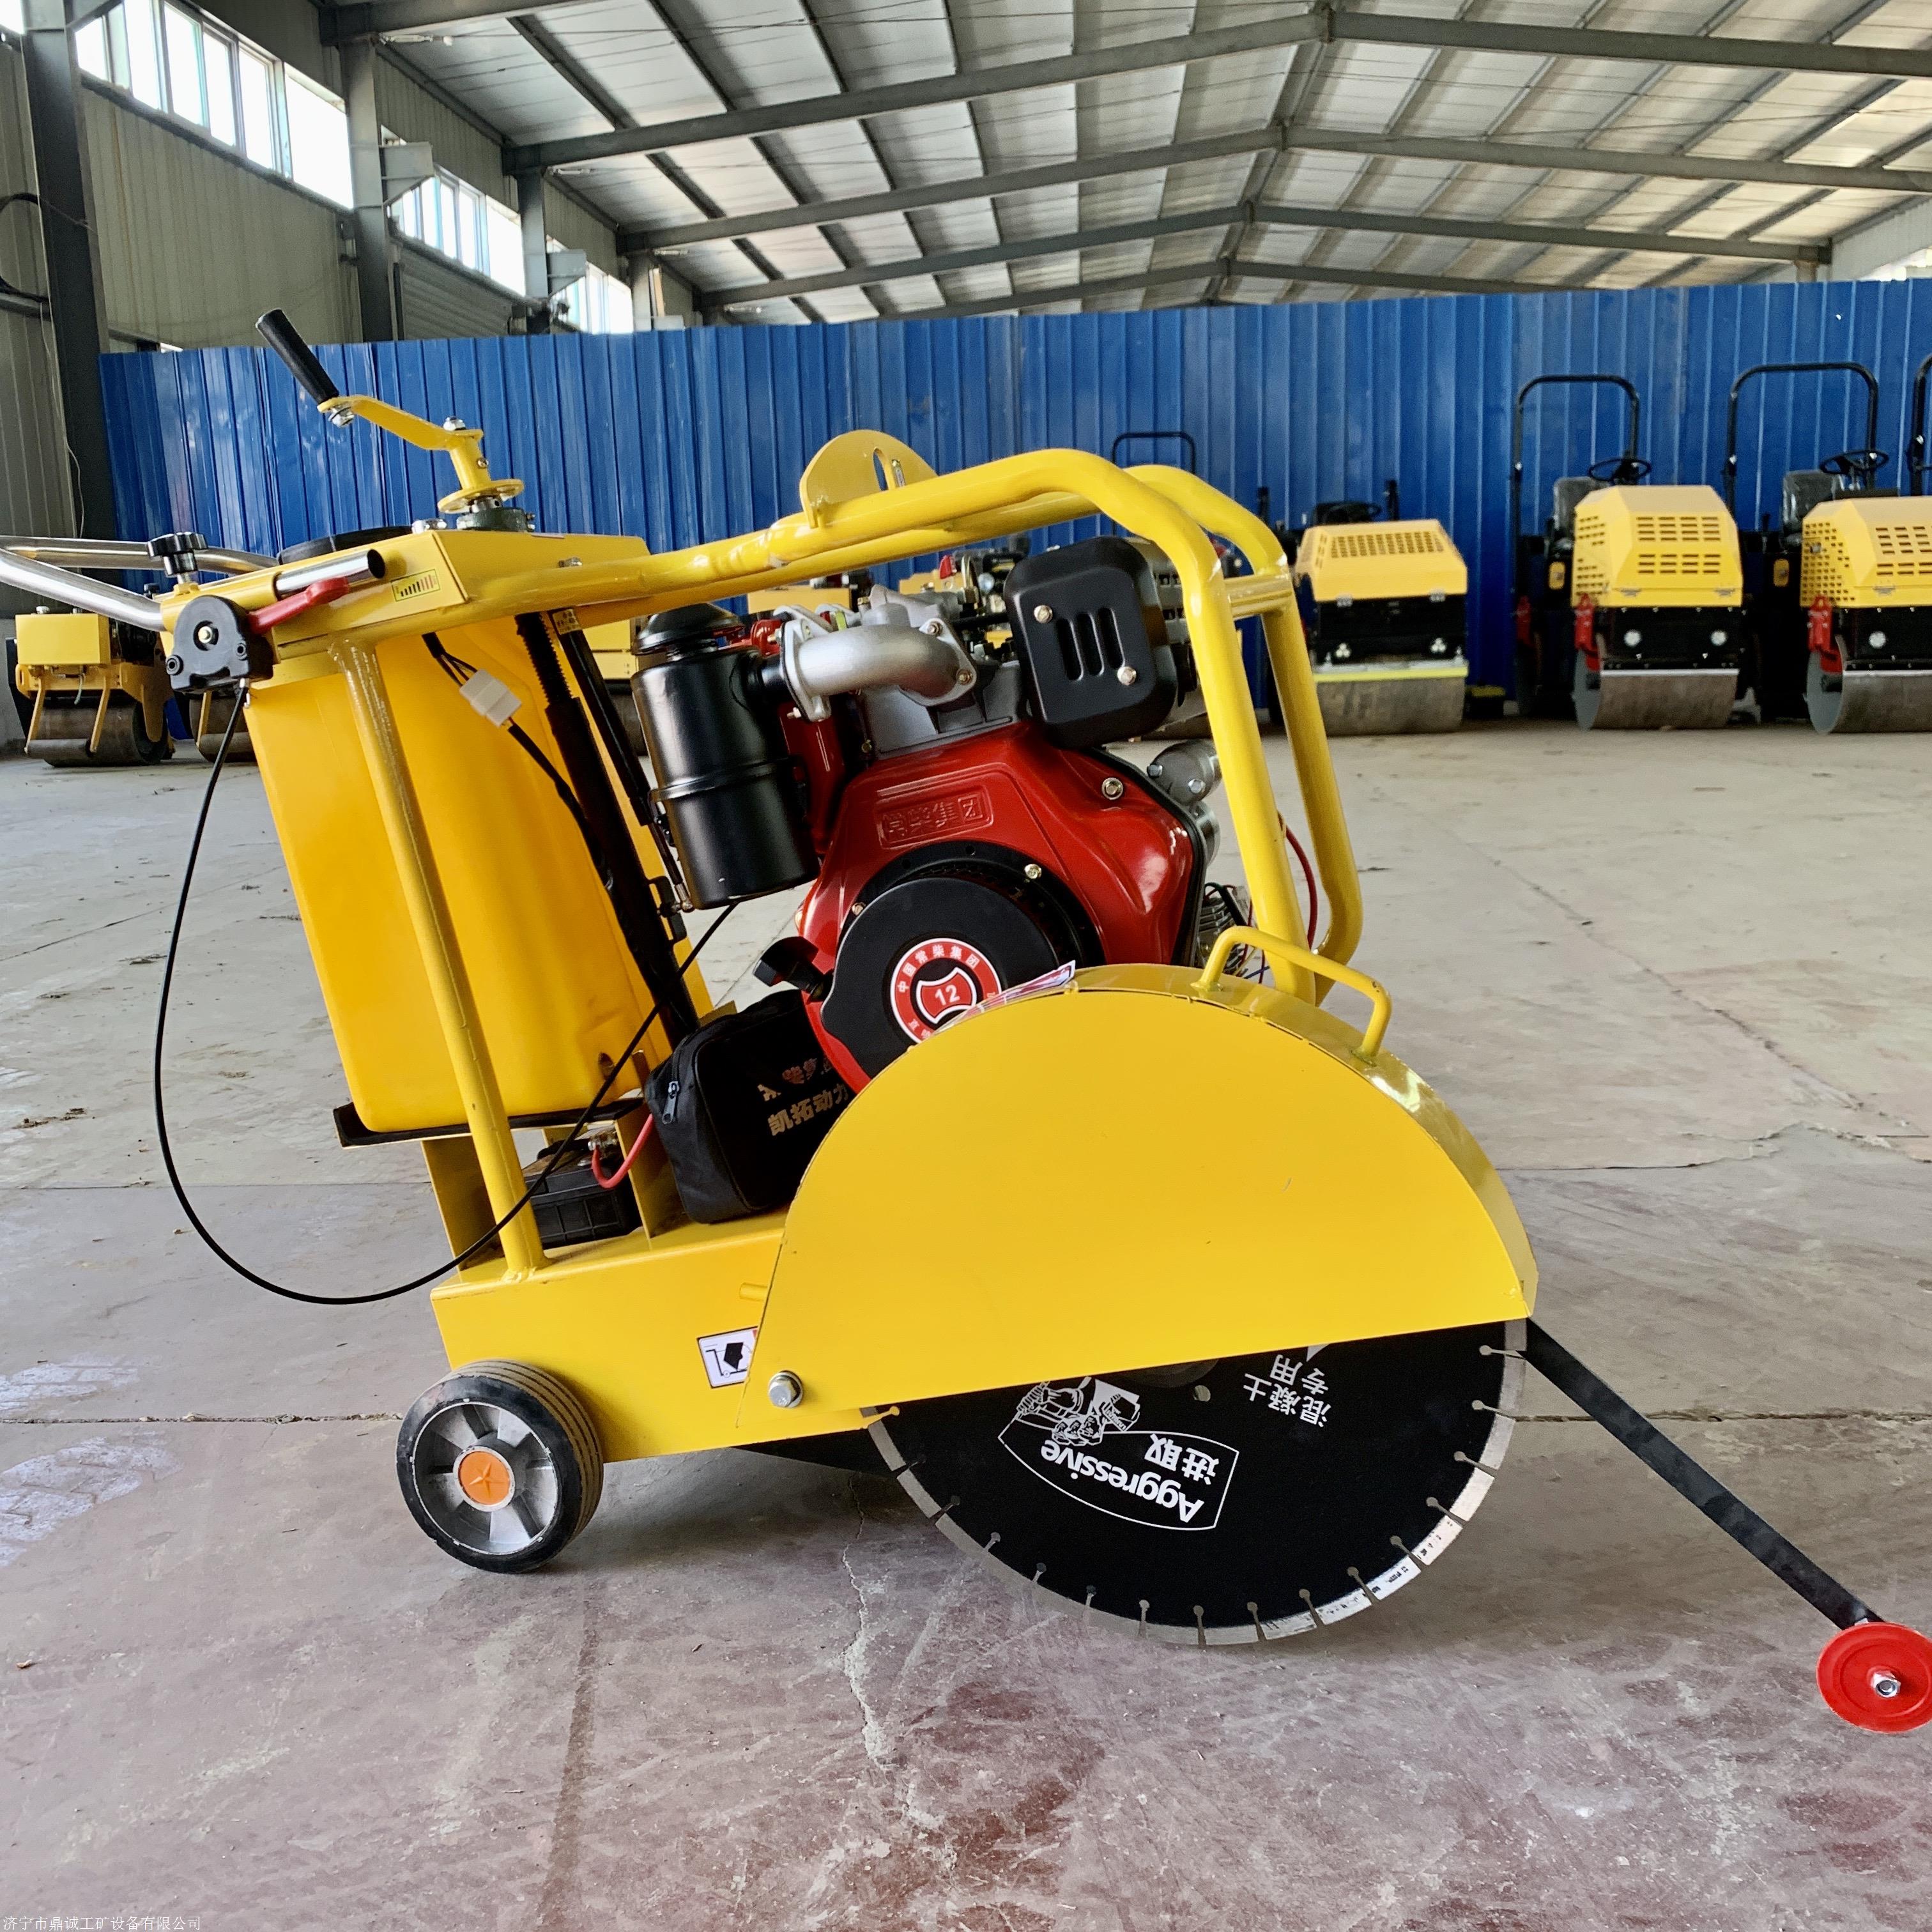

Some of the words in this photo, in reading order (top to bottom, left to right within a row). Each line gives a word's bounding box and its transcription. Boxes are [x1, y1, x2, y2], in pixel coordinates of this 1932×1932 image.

[897, 944, 980, 993] 中国常柴集团
[934, 984, 961, 1006] 12
[1242, 1372, 1333, 1429] 混凝土
[1269, 1353, 1330, 1397] 专用
[1039, 1439, 1205, 1524] Aggressive
[1143, 1432, 1220, 1485] 进取
